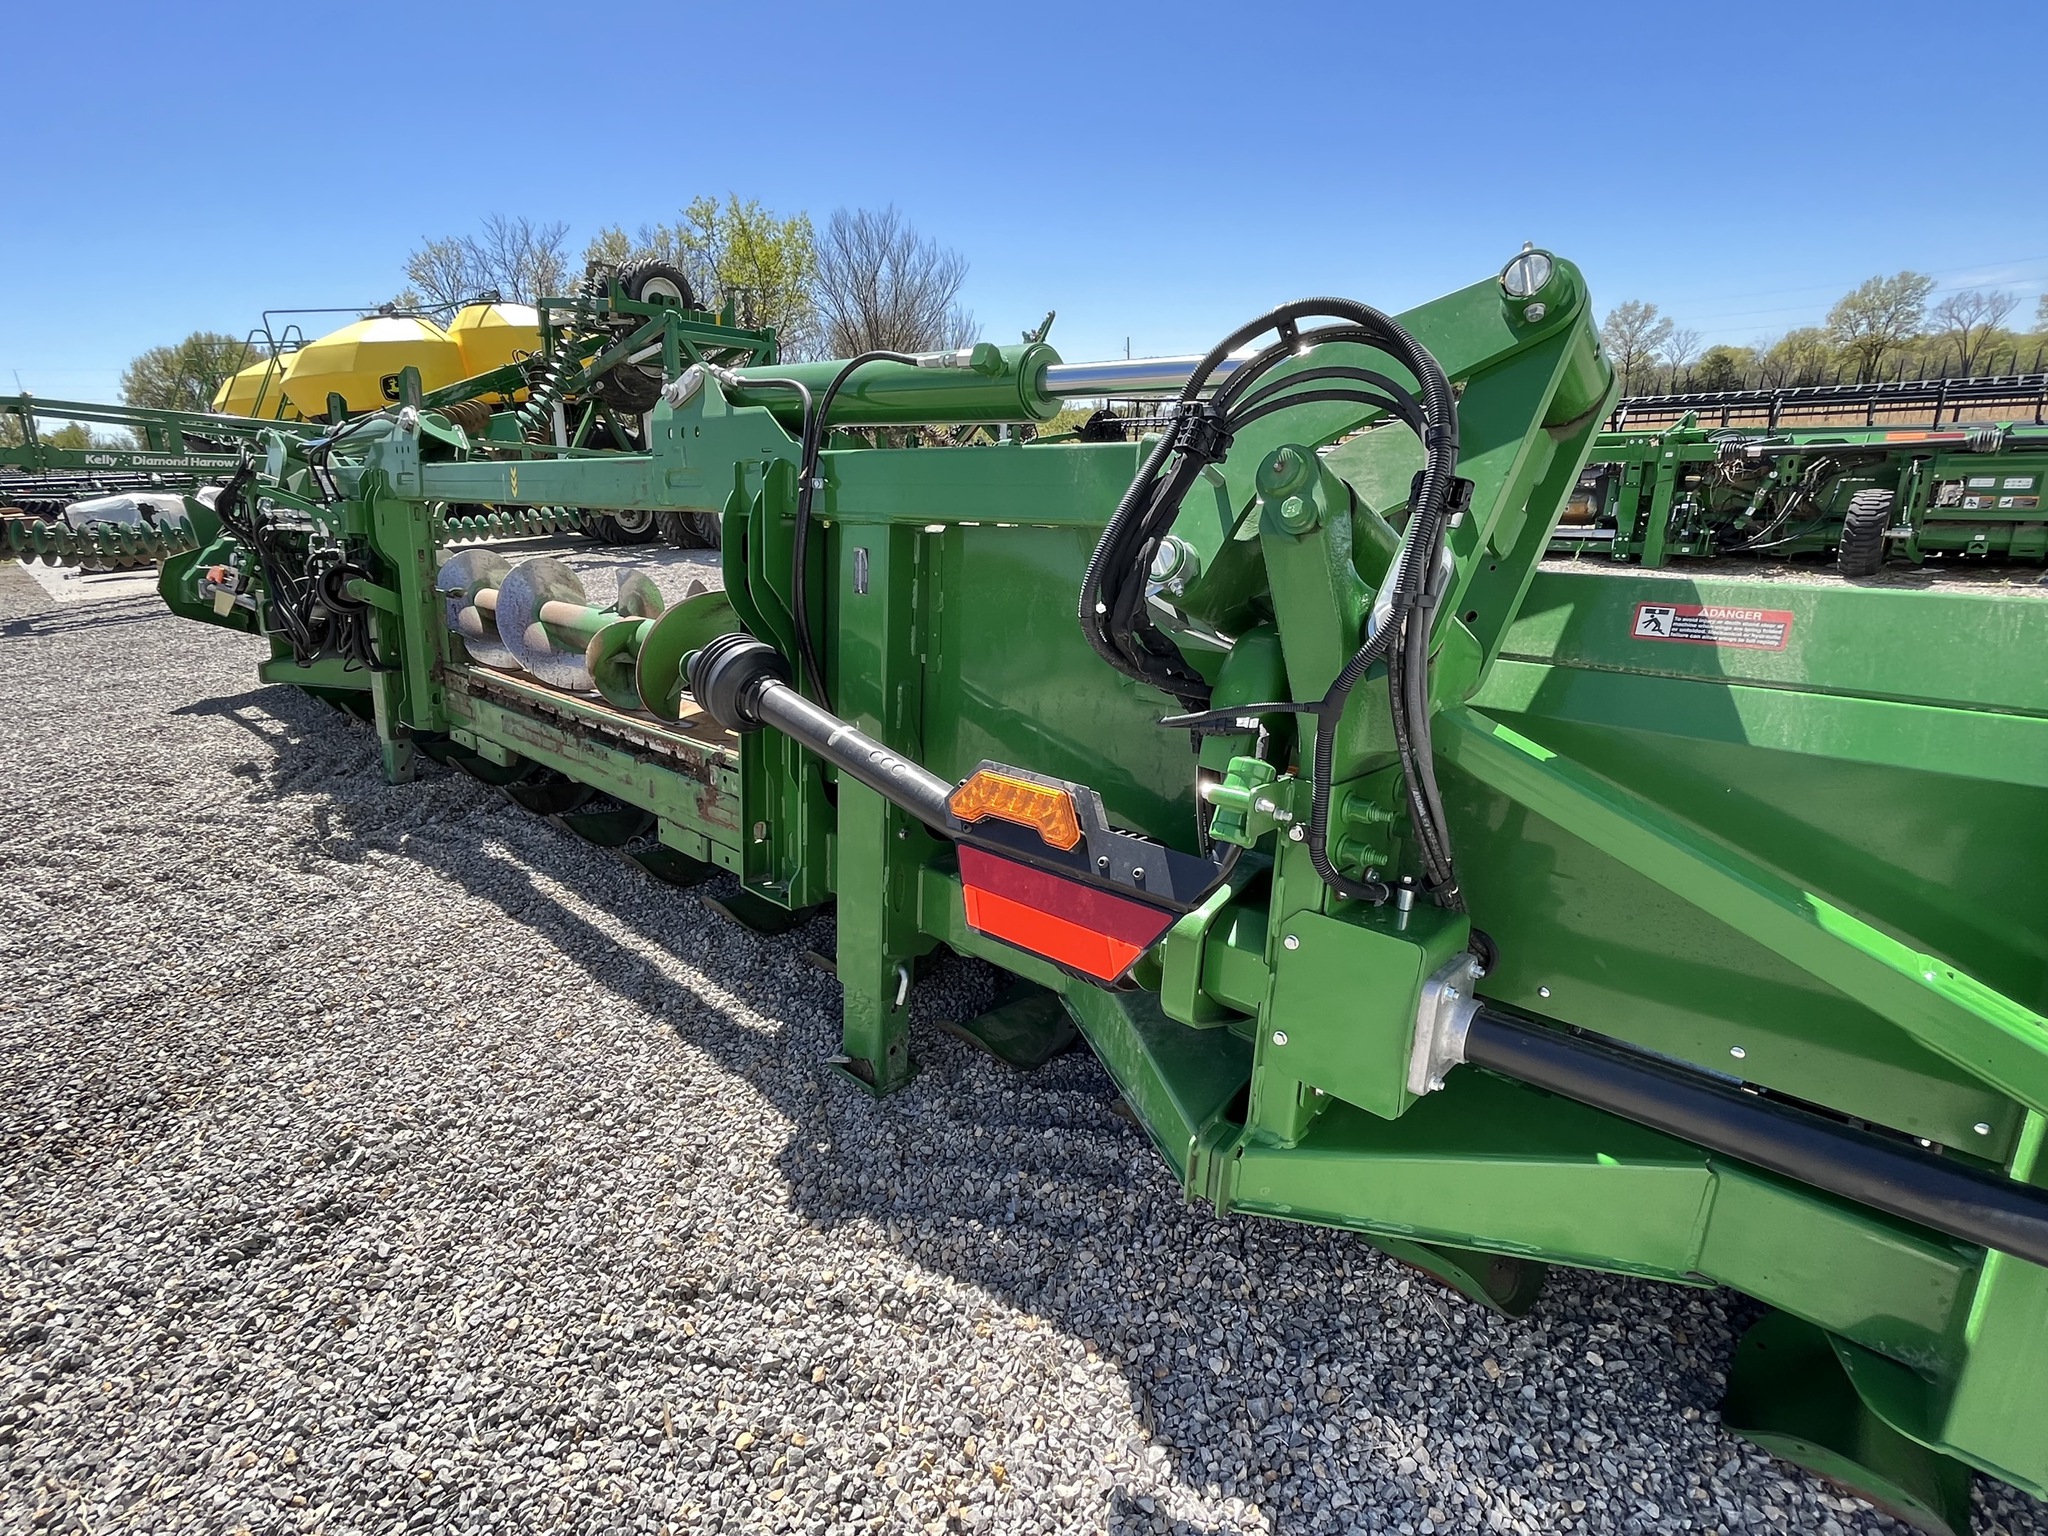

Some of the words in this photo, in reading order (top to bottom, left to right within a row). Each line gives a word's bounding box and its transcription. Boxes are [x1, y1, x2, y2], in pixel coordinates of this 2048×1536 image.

[85, 454, 117, 467] Kelly
[132, 455, 189, 467] Diamond
[190, 457, 235, 467] Harrow
[1709, 609, 1763, 621] DANGER
